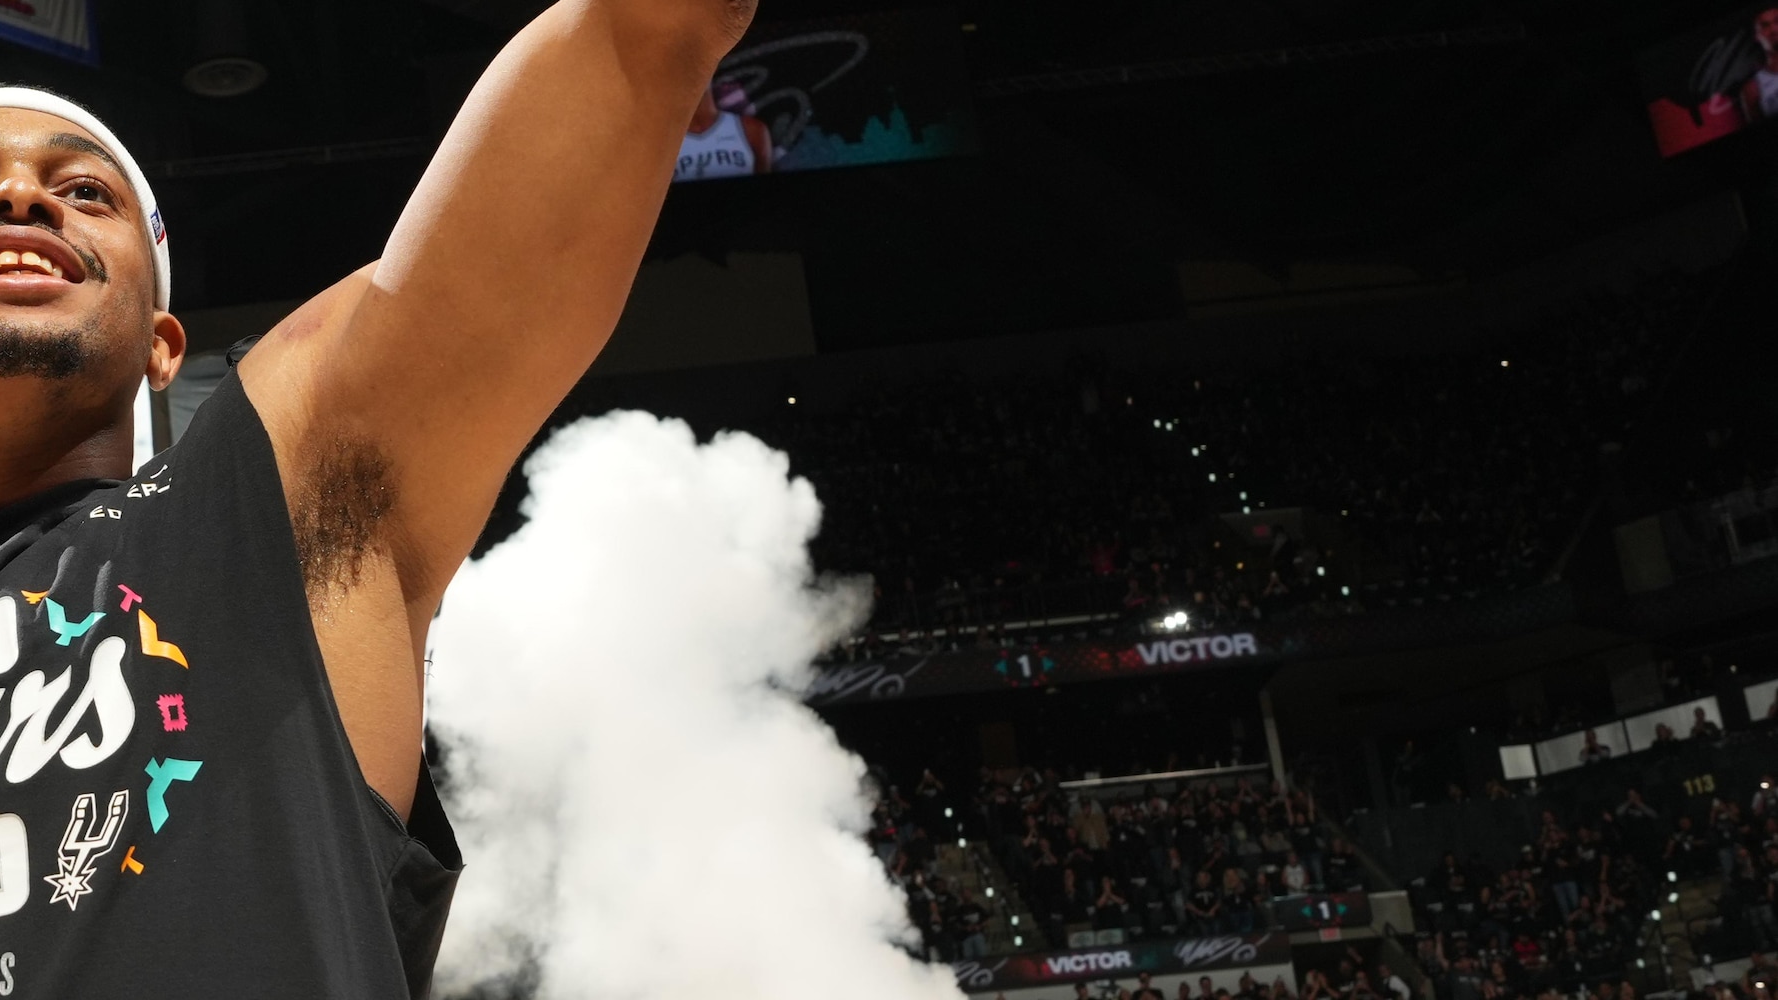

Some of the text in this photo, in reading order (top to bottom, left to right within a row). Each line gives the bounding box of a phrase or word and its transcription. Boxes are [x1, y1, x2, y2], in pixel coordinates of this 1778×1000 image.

[674, 150, 747, 178] PURS
[1016, 632, 1257, 679] 1 VICTOR
[1683, 774, 1716, 796] 113
[1318, 900, 1331, 920] 1
[1046, 949, 1133, 975] VICTOR
